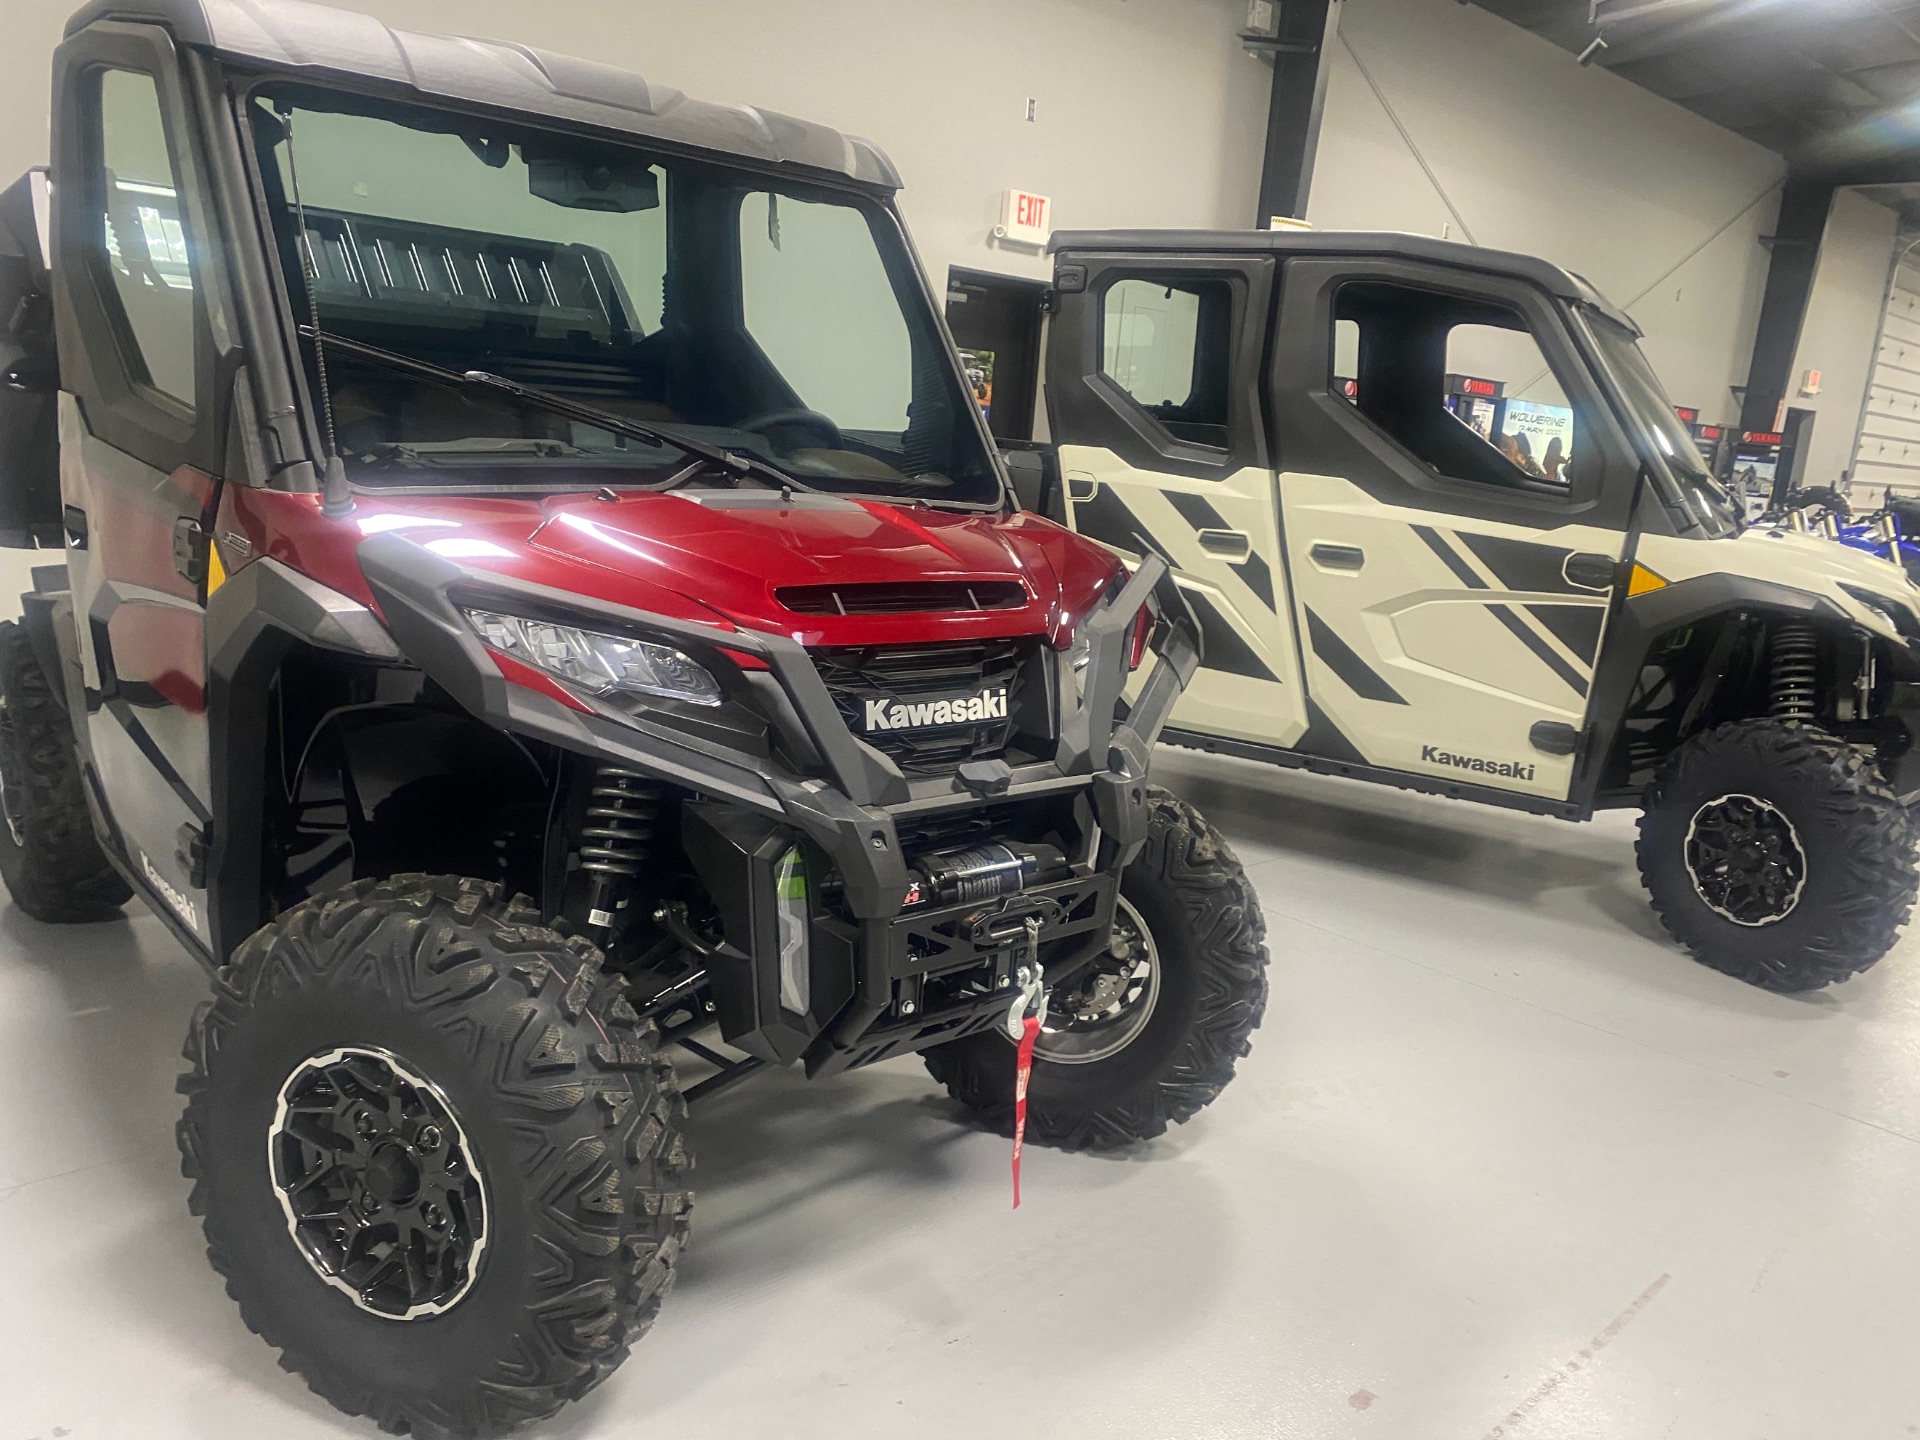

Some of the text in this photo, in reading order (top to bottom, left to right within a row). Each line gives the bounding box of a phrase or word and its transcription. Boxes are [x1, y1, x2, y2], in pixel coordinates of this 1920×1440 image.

[1017, 194, 1046, 229] EXIT
[1509, 410, 1567, 427] WOLVERINE
[864, 688, 1008, 731] Kawasaki
[1421, 744, 1535, 781] Kawasaki
[139, 850, 198, 931] Kawasaki
